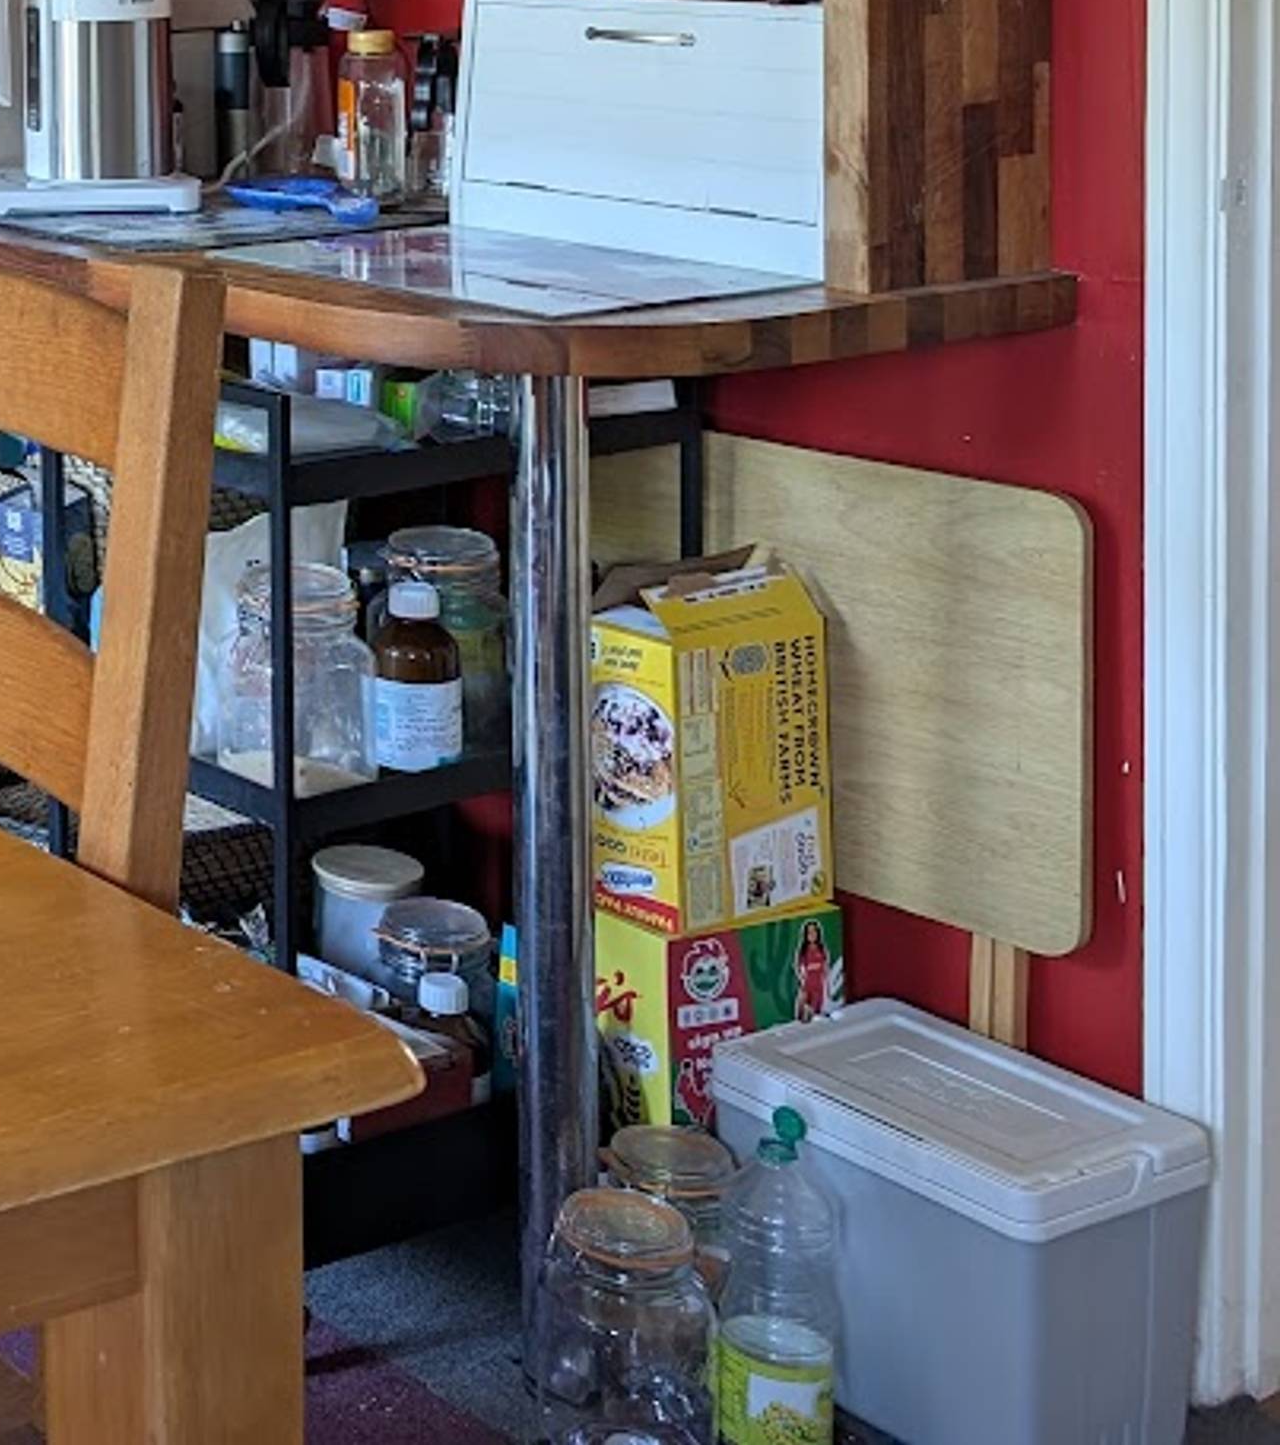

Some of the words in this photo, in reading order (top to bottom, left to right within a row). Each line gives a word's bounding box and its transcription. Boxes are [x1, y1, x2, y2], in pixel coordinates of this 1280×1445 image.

[774, 640, 791, 726] BRITISH
[790, 639, 806, 716] WHEAT
[803, 635, 822, 790] HOMEGROWN
[778, 731, 793, 805] FARMS
[793, 723, 806, 787] FROM
